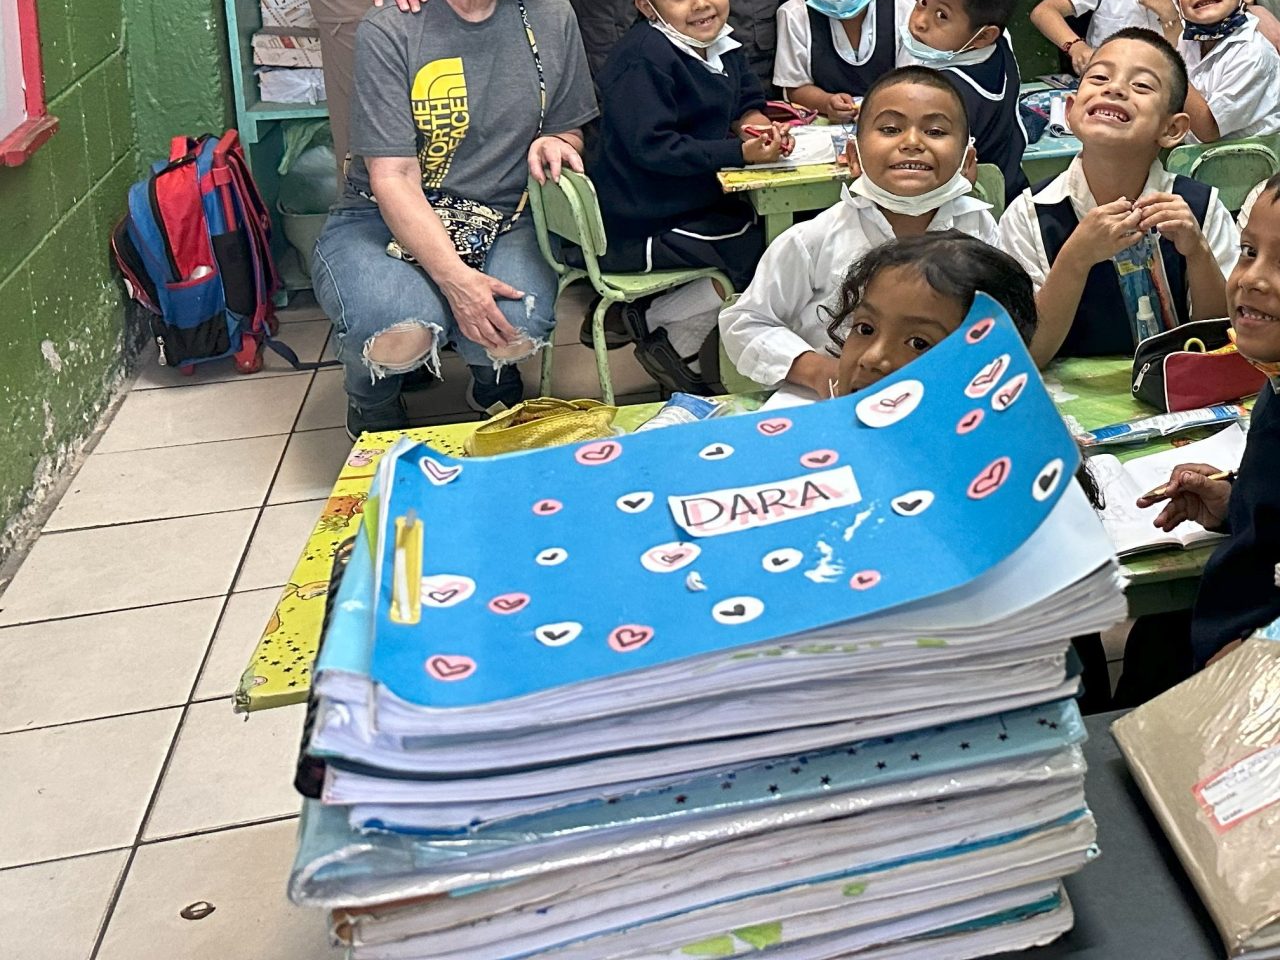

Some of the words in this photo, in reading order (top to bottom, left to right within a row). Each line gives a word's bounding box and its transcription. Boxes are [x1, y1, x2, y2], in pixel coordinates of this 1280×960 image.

[425, 98, 451, 171] NORTH
[448, 96, 470, 151] FACE
[681, 480, 832, 528] DARA
